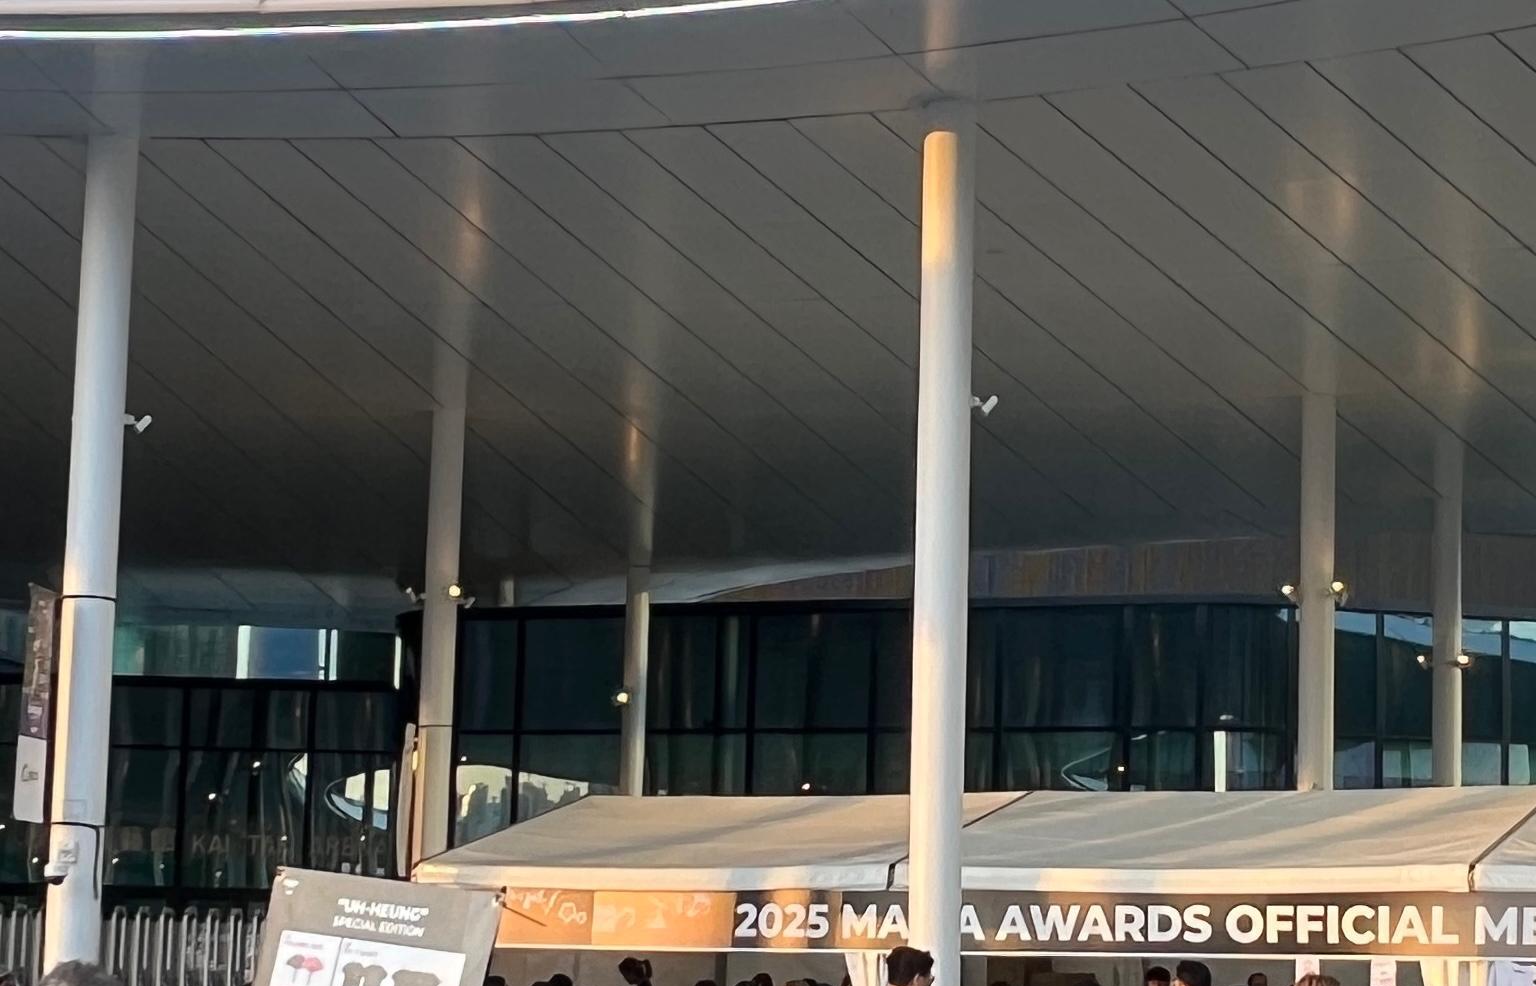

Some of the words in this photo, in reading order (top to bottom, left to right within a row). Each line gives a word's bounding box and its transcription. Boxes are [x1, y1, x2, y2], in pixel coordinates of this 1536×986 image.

[734, 902, 830, 939] 2025
[841, 903, 986, 941] MAA
[995, 904, 1212, 943] AWARDS
[1224, 904, 1460, 945] OFFICIAL
